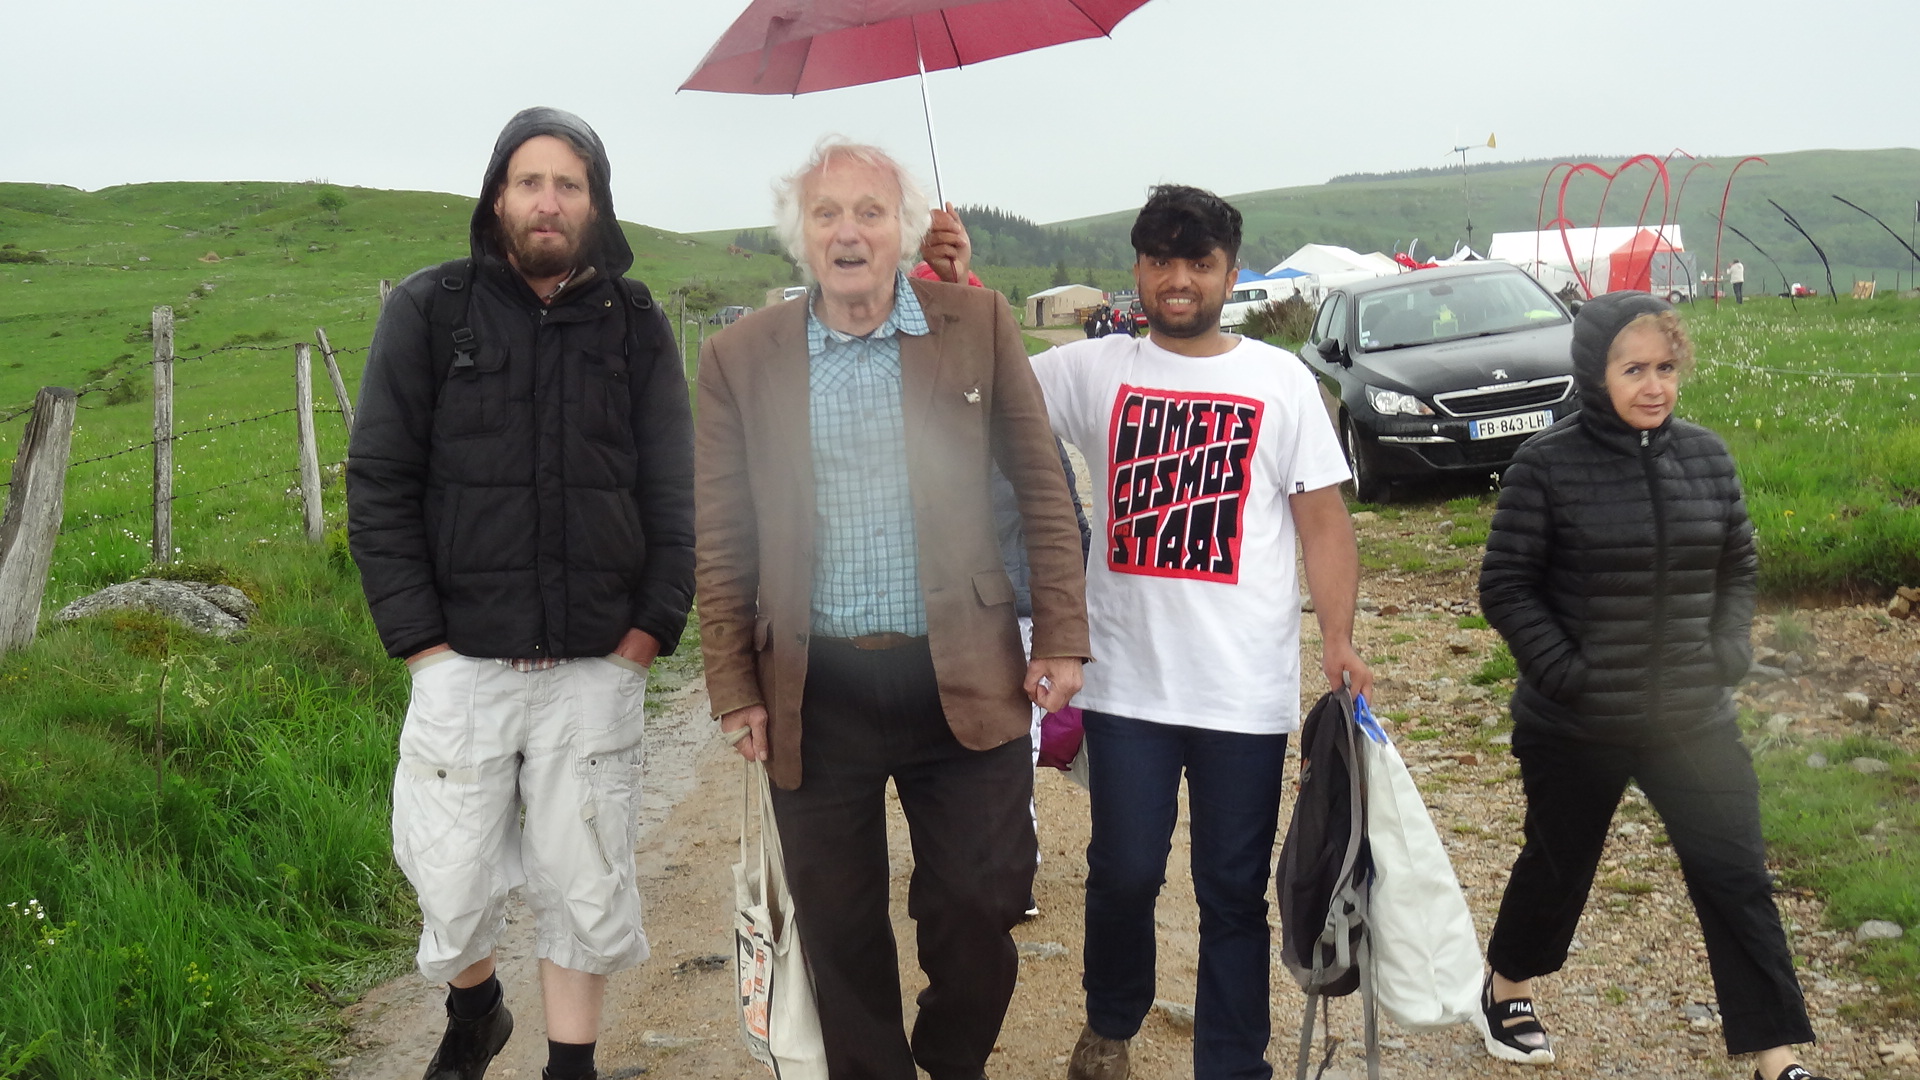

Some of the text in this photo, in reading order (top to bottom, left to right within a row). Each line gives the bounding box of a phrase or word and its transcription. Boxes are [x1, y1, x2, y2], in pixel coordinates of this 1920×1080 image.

[1114, 391, 1256, 464] COMETS
[1479, 414, 1545, 437] FB-843-LH
[1114, 439, 1250, 521] COSMOS
[1112, 493, 1240, 575] STARS
[1509, 1001, 1532, 1014] FILA
